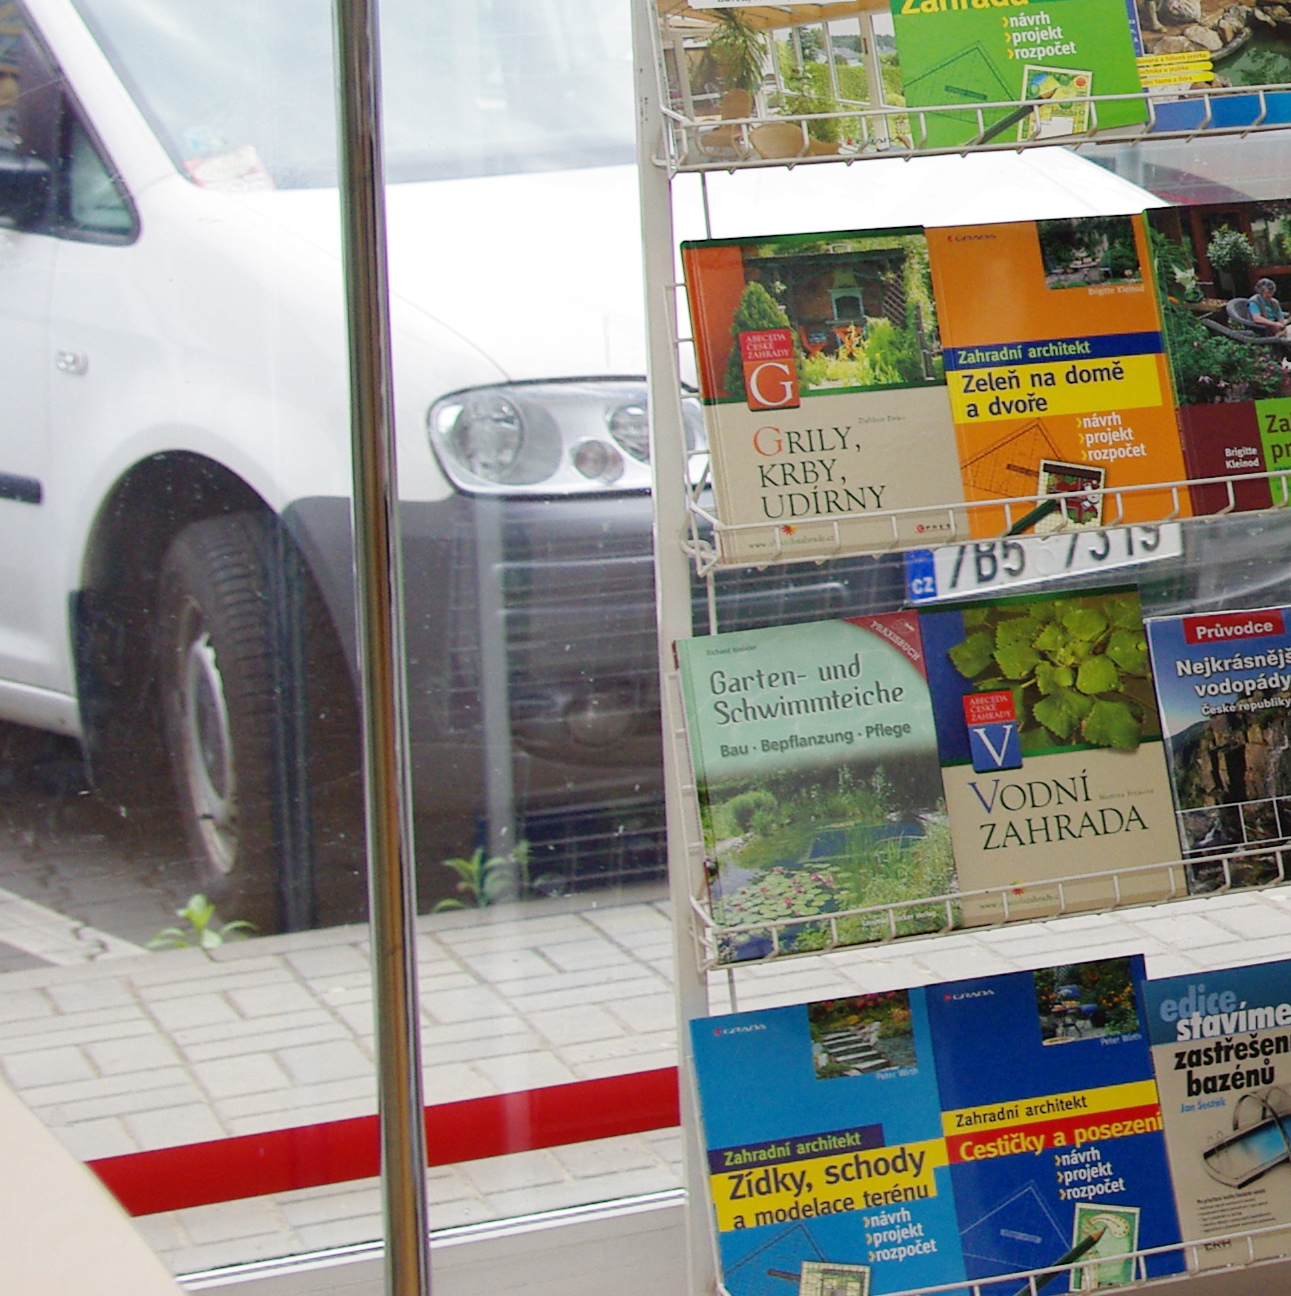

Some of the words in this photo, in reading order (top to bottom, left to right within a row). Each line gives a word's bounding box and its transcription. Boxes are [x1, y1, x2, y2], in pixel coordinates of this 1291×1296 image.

[1009, 12, 1051, 27] návrh
[1012, 27, 1063, 45] projekt
[1014, 42, 1076, 60] rozpočet
[962, 368, 1020, 393] Zeleň
[1031, 372, 1057, 387] na
[1065, 362, 1124, 383] domě
[966, 403, 979, 417] a
[989, 393, 1048, 415] dvoře
[753, 425, 861, 456] GRILY,
[759, 458, 846, 488] KRBY,
[762, 483, 885, 519] UDÍRNY
[912, 578, 934, 594] CZ
[870, 621, 920, 662] PRAXISBUCH
[1196, 619, 1274, 639] Průvodce
[710, 667, 808, 695] Garten-
[819, 654, 862, 679] und
[1194, 673, 1291, 698] vodopády
[714, 683, 904, 725] Schwimmteiche
[721, 744, 749, 757] Bau
[761, 729, 854, 754] Bepflanzung
[865, 722, 911, 740] Pflege
[968, 770, 1092, 814] VODNÍ
[981, 805, 1149, 851] ZAHRADA
[1160, 984, 1236, 1023] edice
[1187, 1059, 1275, 1097] bazénů
[724, 1141, 792, 1166] Zahradní
[797, 1131, 861, 1154] architekt
[960, 1131, 1046, 1161] Cestičky
[1053, 1132, 1066, 1147] a
[1074, 1112, 1163, 1147] posezení
[729, 1165, 813, 1200] Zídky,
[825, 1147, 925, 1184] schody
[734, 1214, 746, 1229] a
[755, 1194, 855, 1226] modelace
[863, 1180, 928, 1209] terénu
